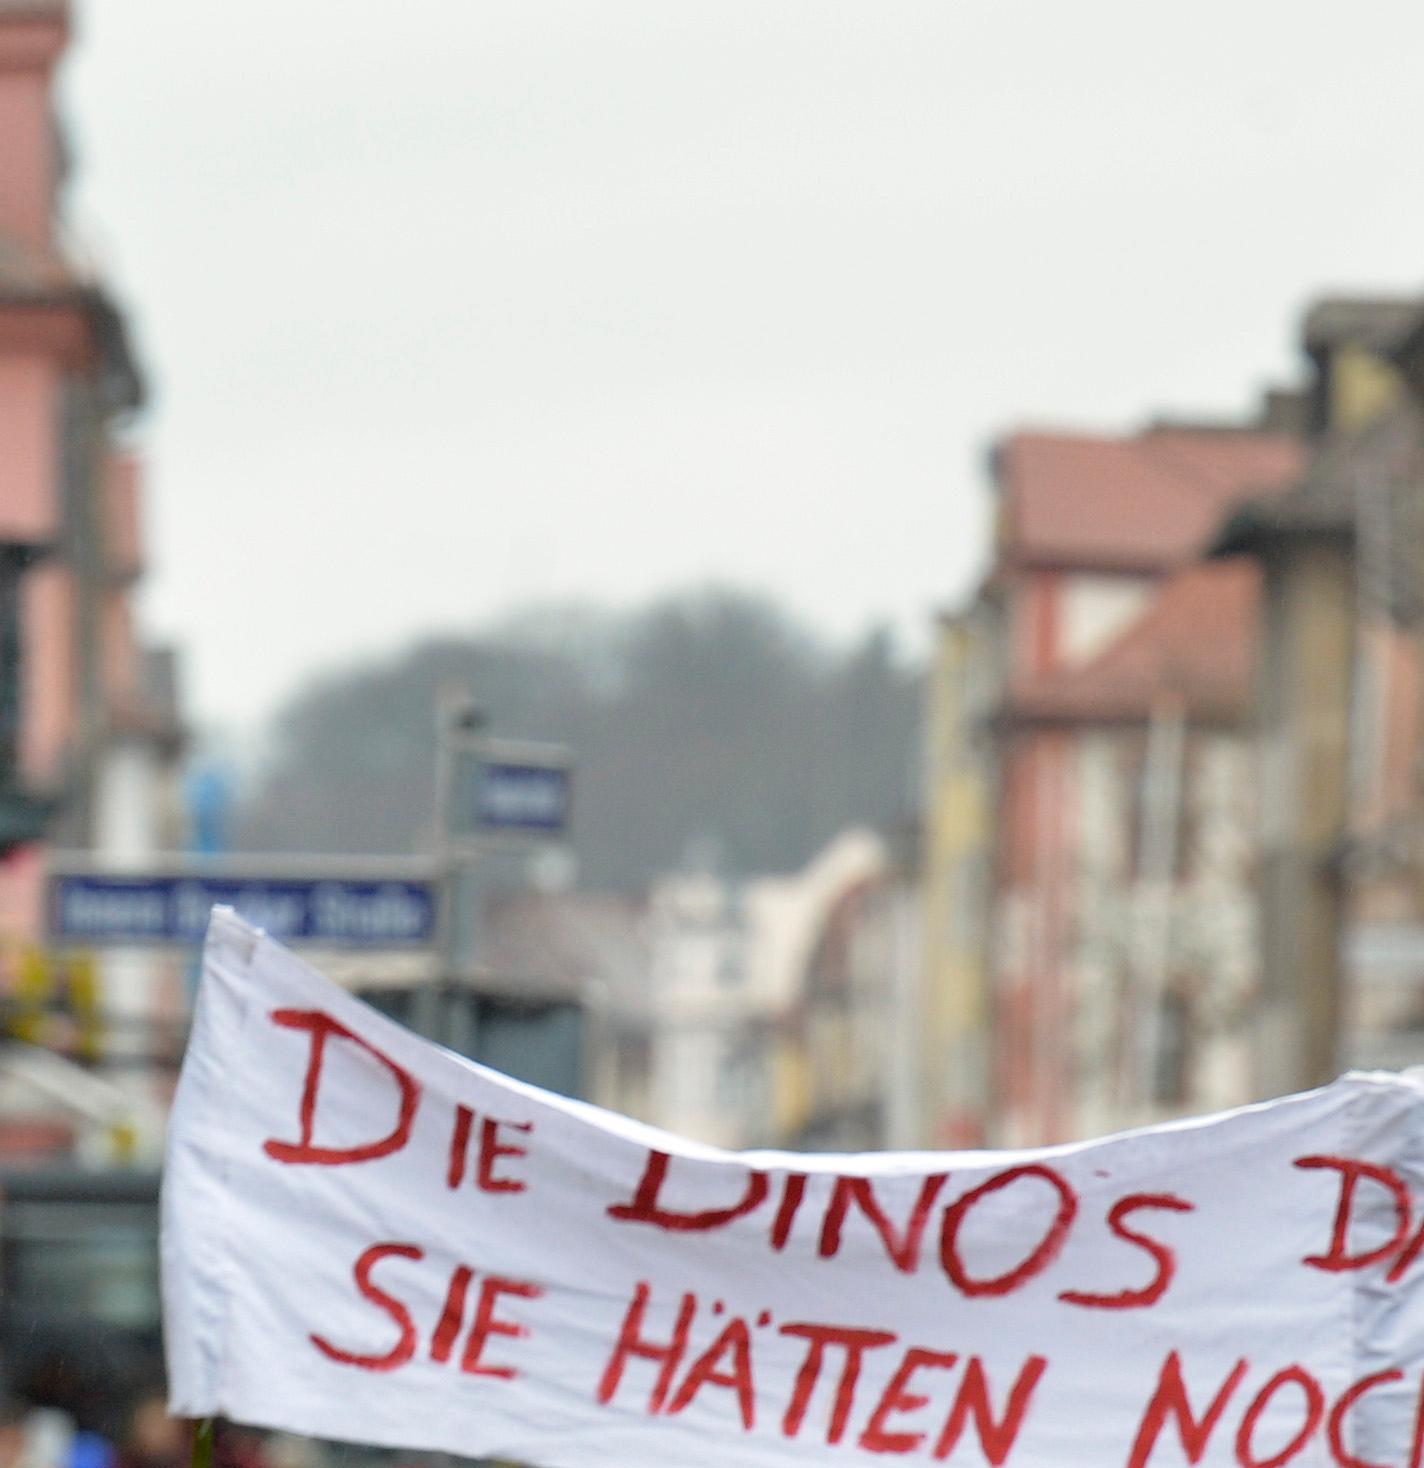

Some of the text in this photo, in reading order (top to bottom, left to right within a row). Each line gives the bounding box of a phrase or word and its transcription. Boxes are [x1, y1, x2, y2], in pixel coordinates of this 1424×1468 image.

[263, 1009, 533, 1194] DIE
[607, 1151, 1194, 1310] DINOS
[310, 1243, 541, 1381] SIE
[597, 1282, 1048, 1468] HÄTTEN
